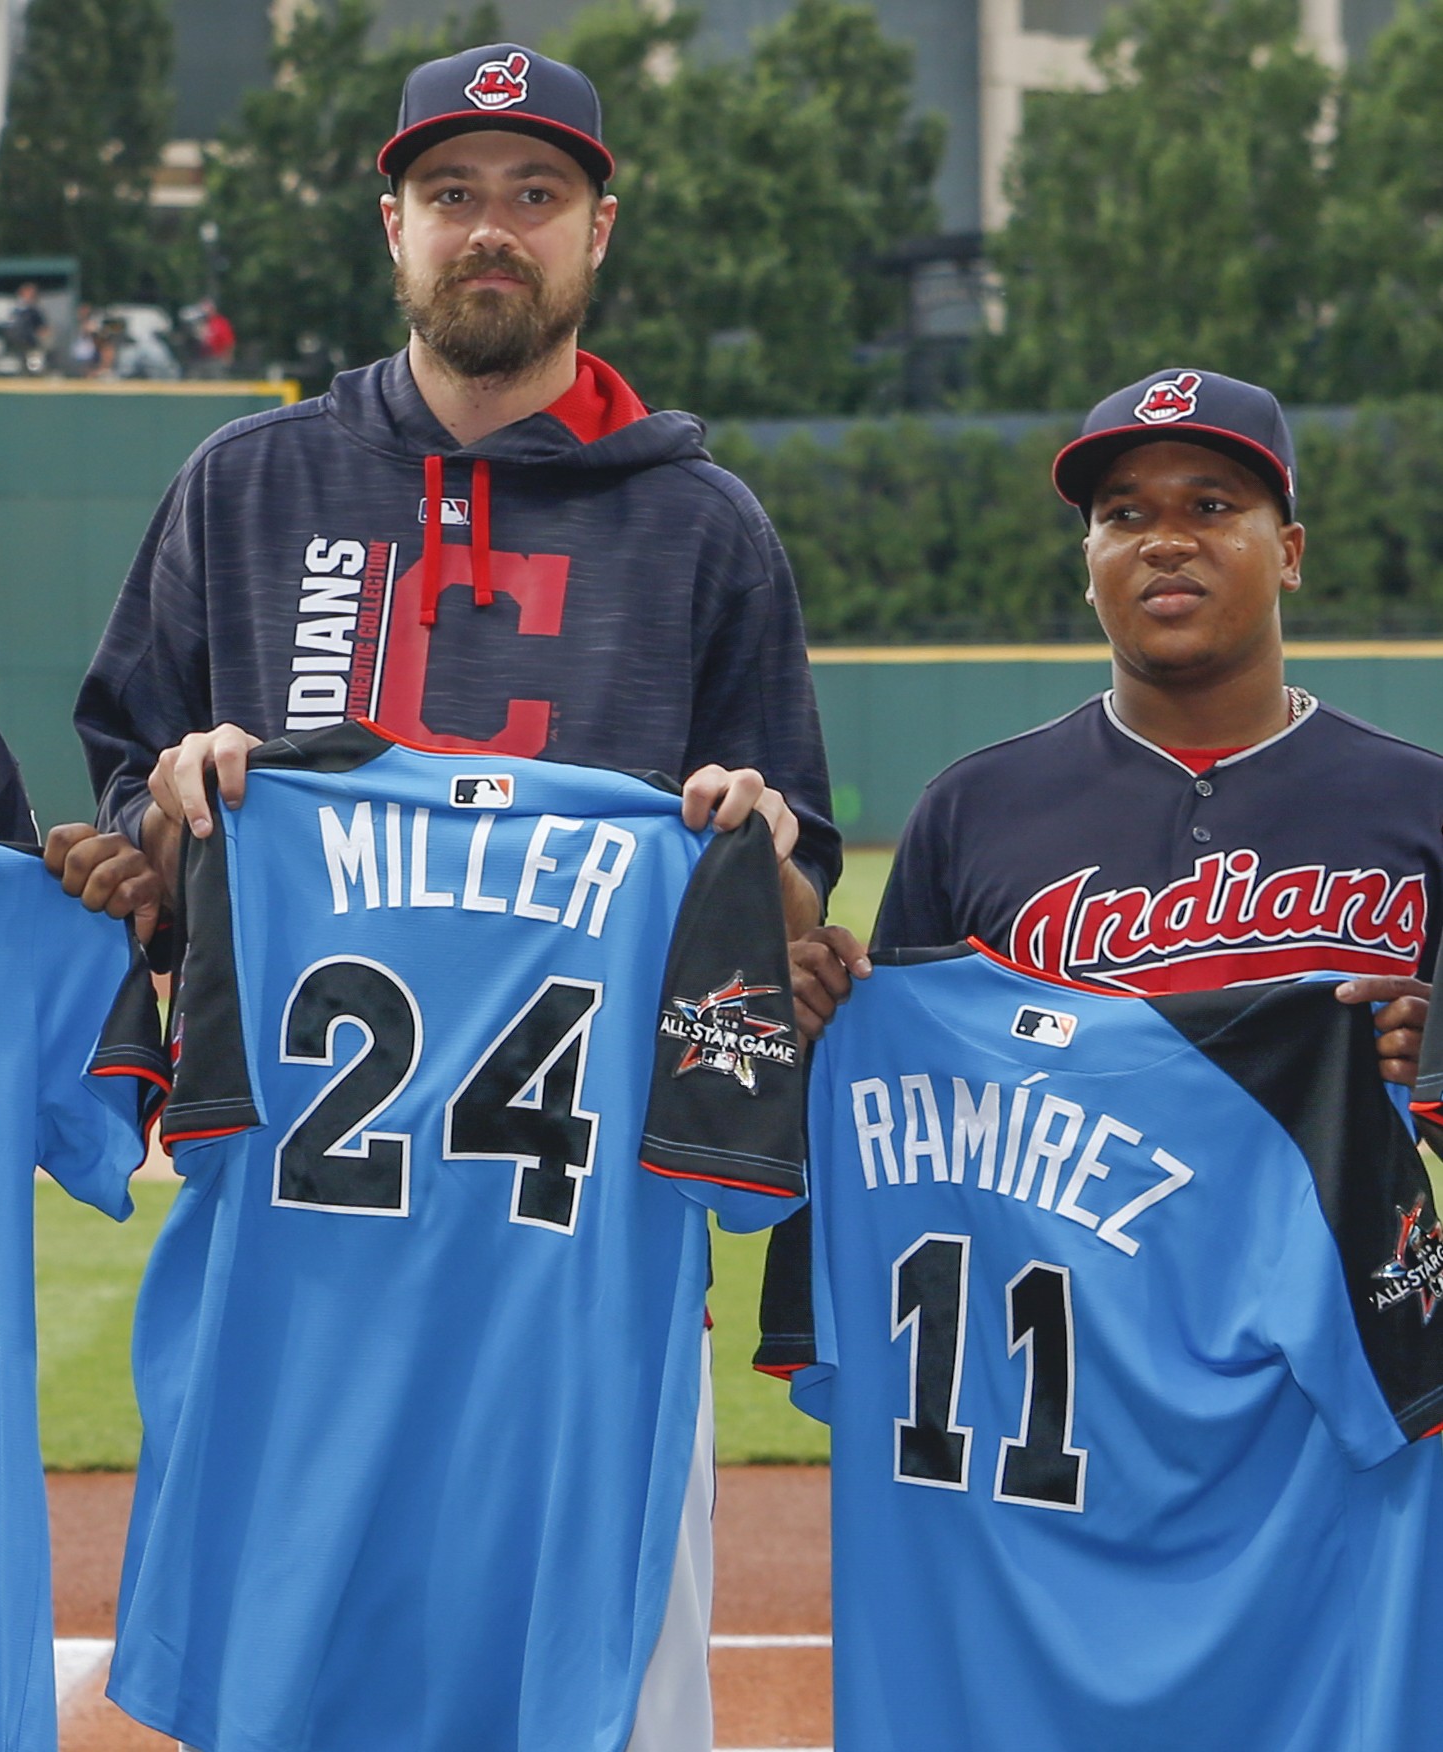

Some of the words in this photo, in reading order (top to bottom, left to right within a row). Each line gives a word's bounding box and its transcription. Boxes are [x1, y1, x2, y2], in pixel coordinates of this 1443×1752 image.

[360, 541, 389, 638] COLLECTION
[347, 642, 377, 720] UTHENTIC
[318, 801, 637, 938] MILLER
[1009, 848, 1427, 993] Indians
[271, 954, 604, 1236] 24
[739, 1034, 796, 1063] GAME
[851, 1072, 1195, 1256] RAMÍREZ
[890, 1232, 1088, 1513] 11
